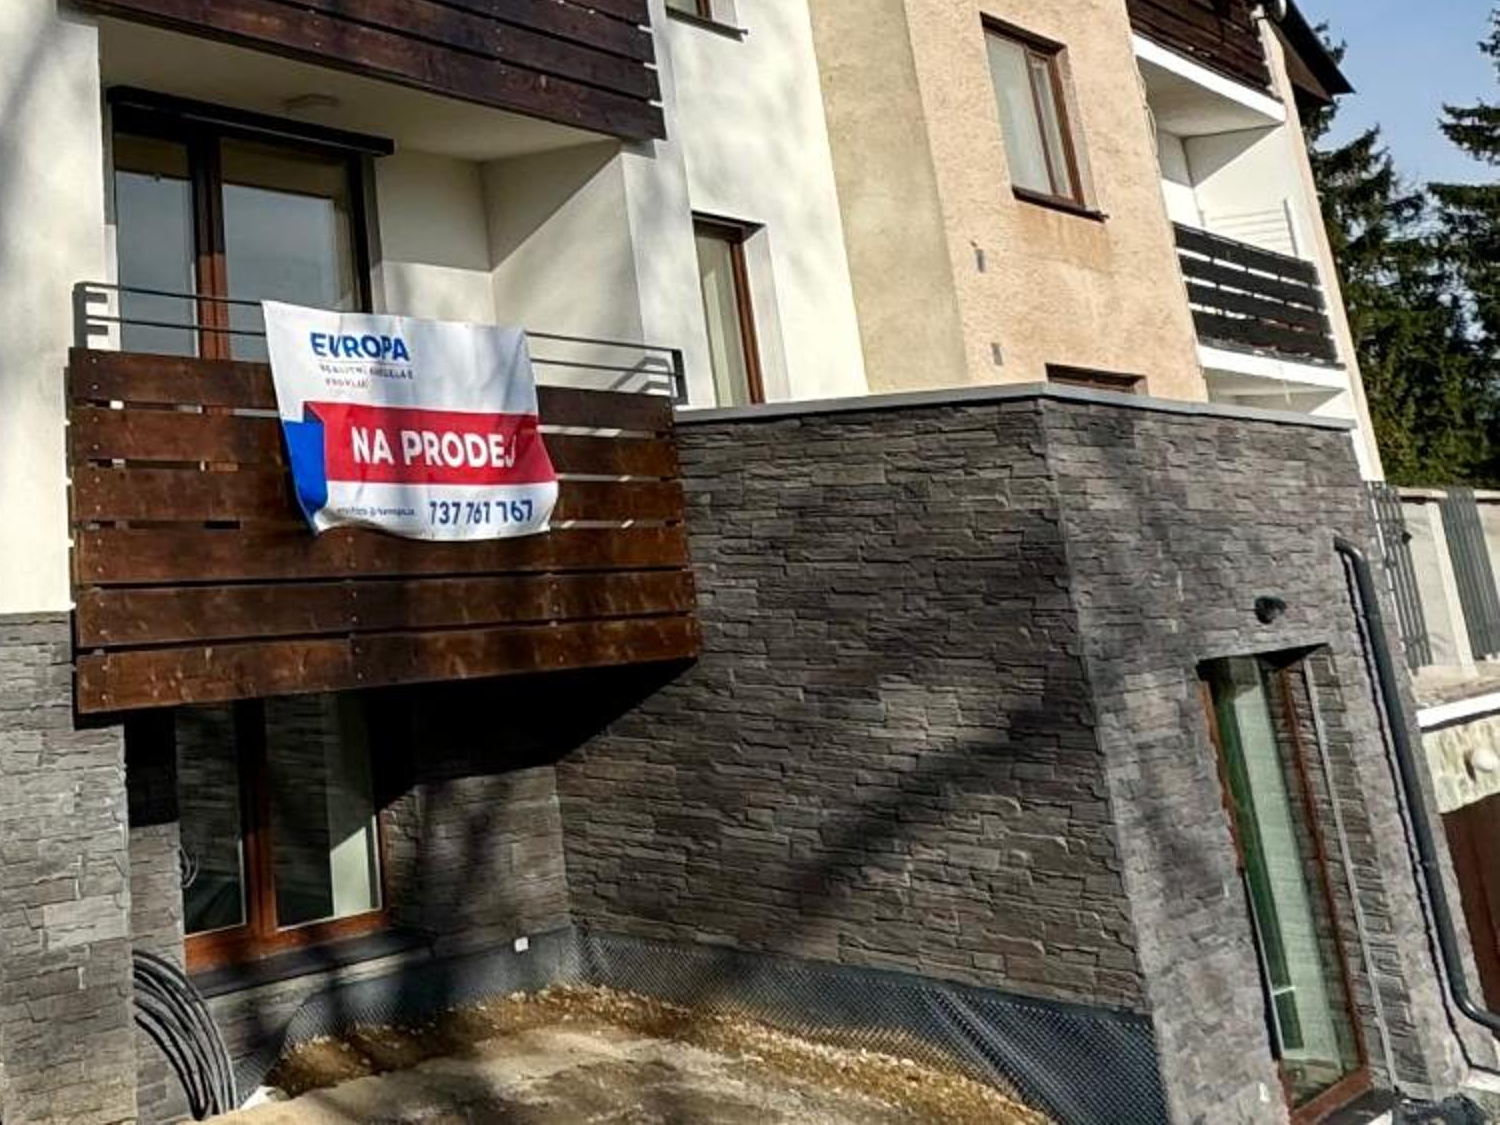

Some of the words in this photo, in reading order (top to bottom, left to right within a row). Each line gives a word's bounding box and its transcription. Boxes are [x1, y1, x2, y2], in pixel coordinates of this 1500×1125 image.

[310, 332, 410, 362] EVROPA
[351, 426, 394, 465] NA
[402, 430, 517, 467] PRODEJ
[495, 499, 533, 523] 767
